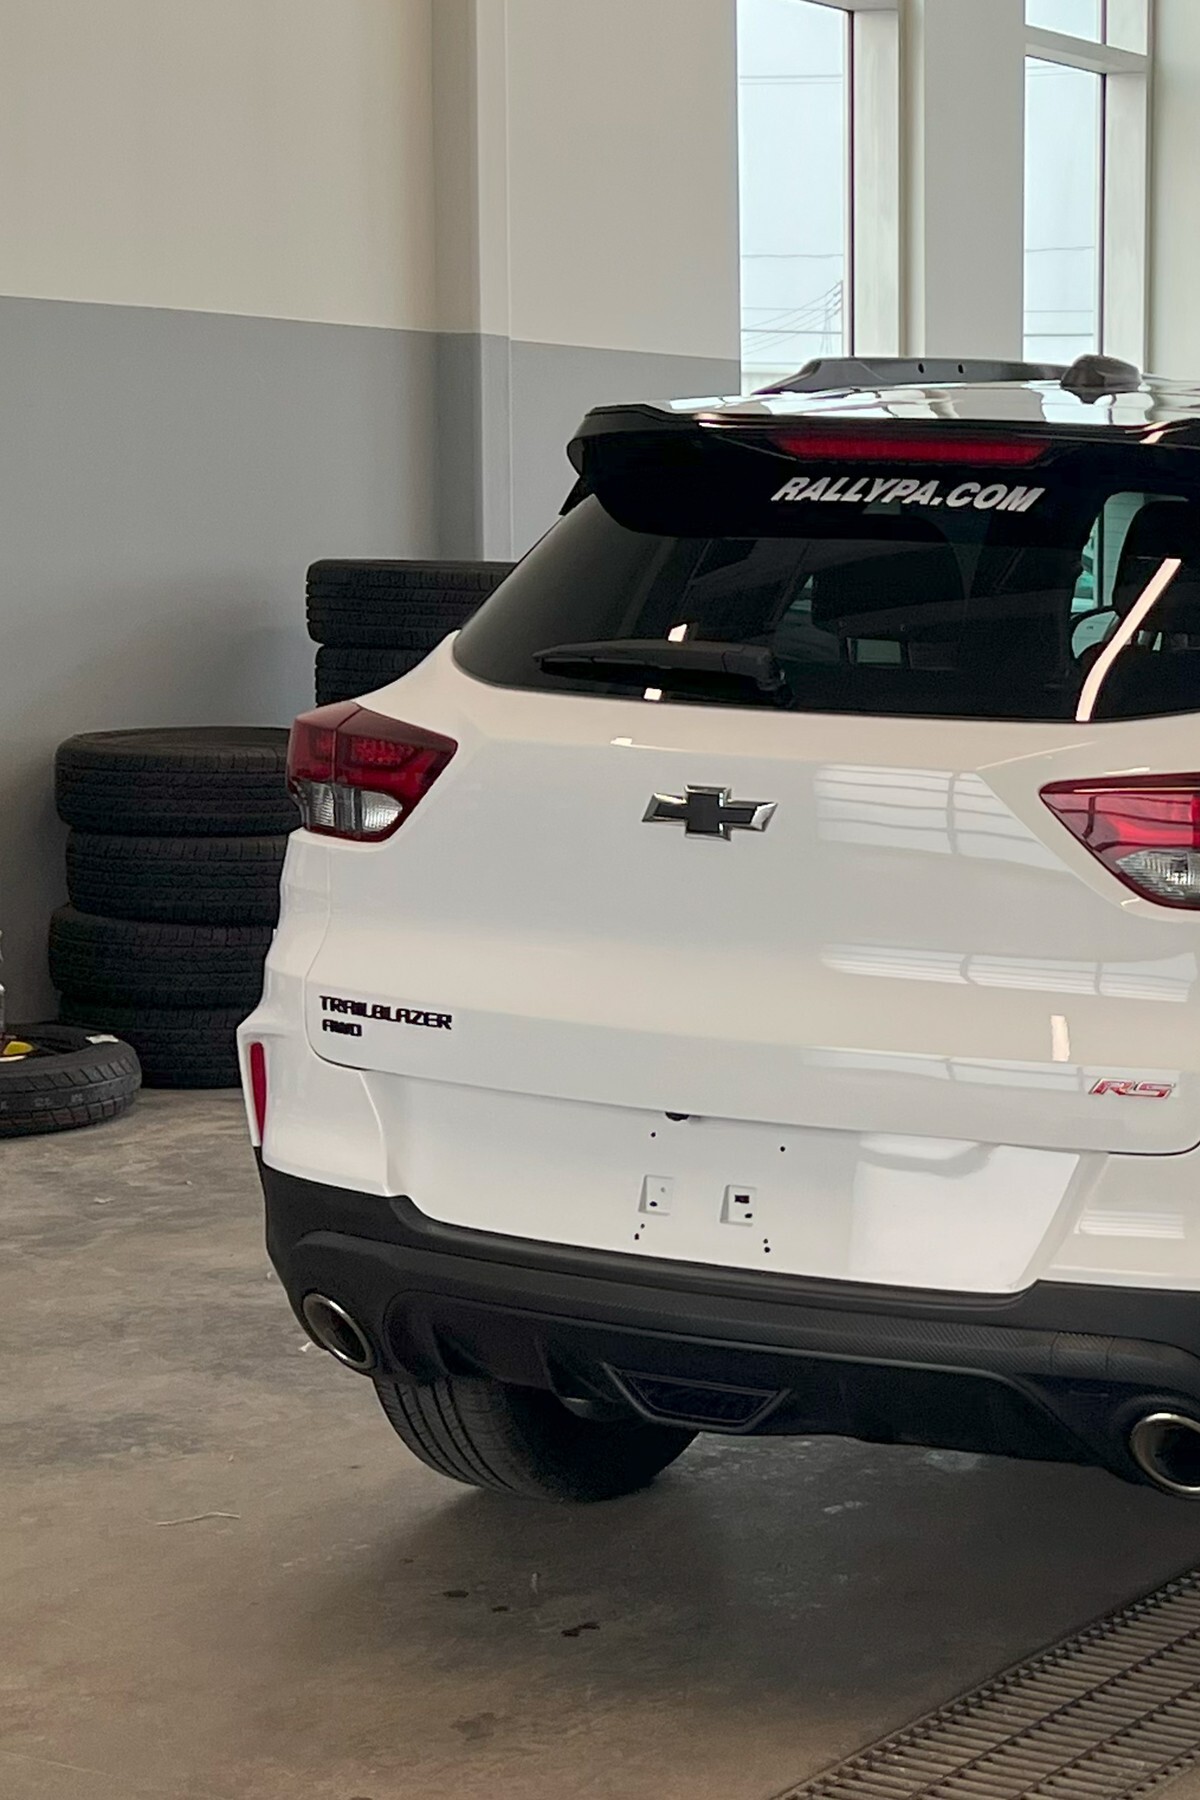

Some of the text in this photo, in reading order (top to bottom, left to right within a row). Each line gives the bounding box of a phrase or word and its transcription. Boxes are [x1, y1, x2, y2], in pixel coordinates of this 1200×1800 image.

[771, 477, 1045, 512] RALLYPA.COM
[319, 995, 452, 1030] TRAILBLAZER
[322, 1019, 362, 1037] AWD
[1088, 1078, 1175, 1099] RS
